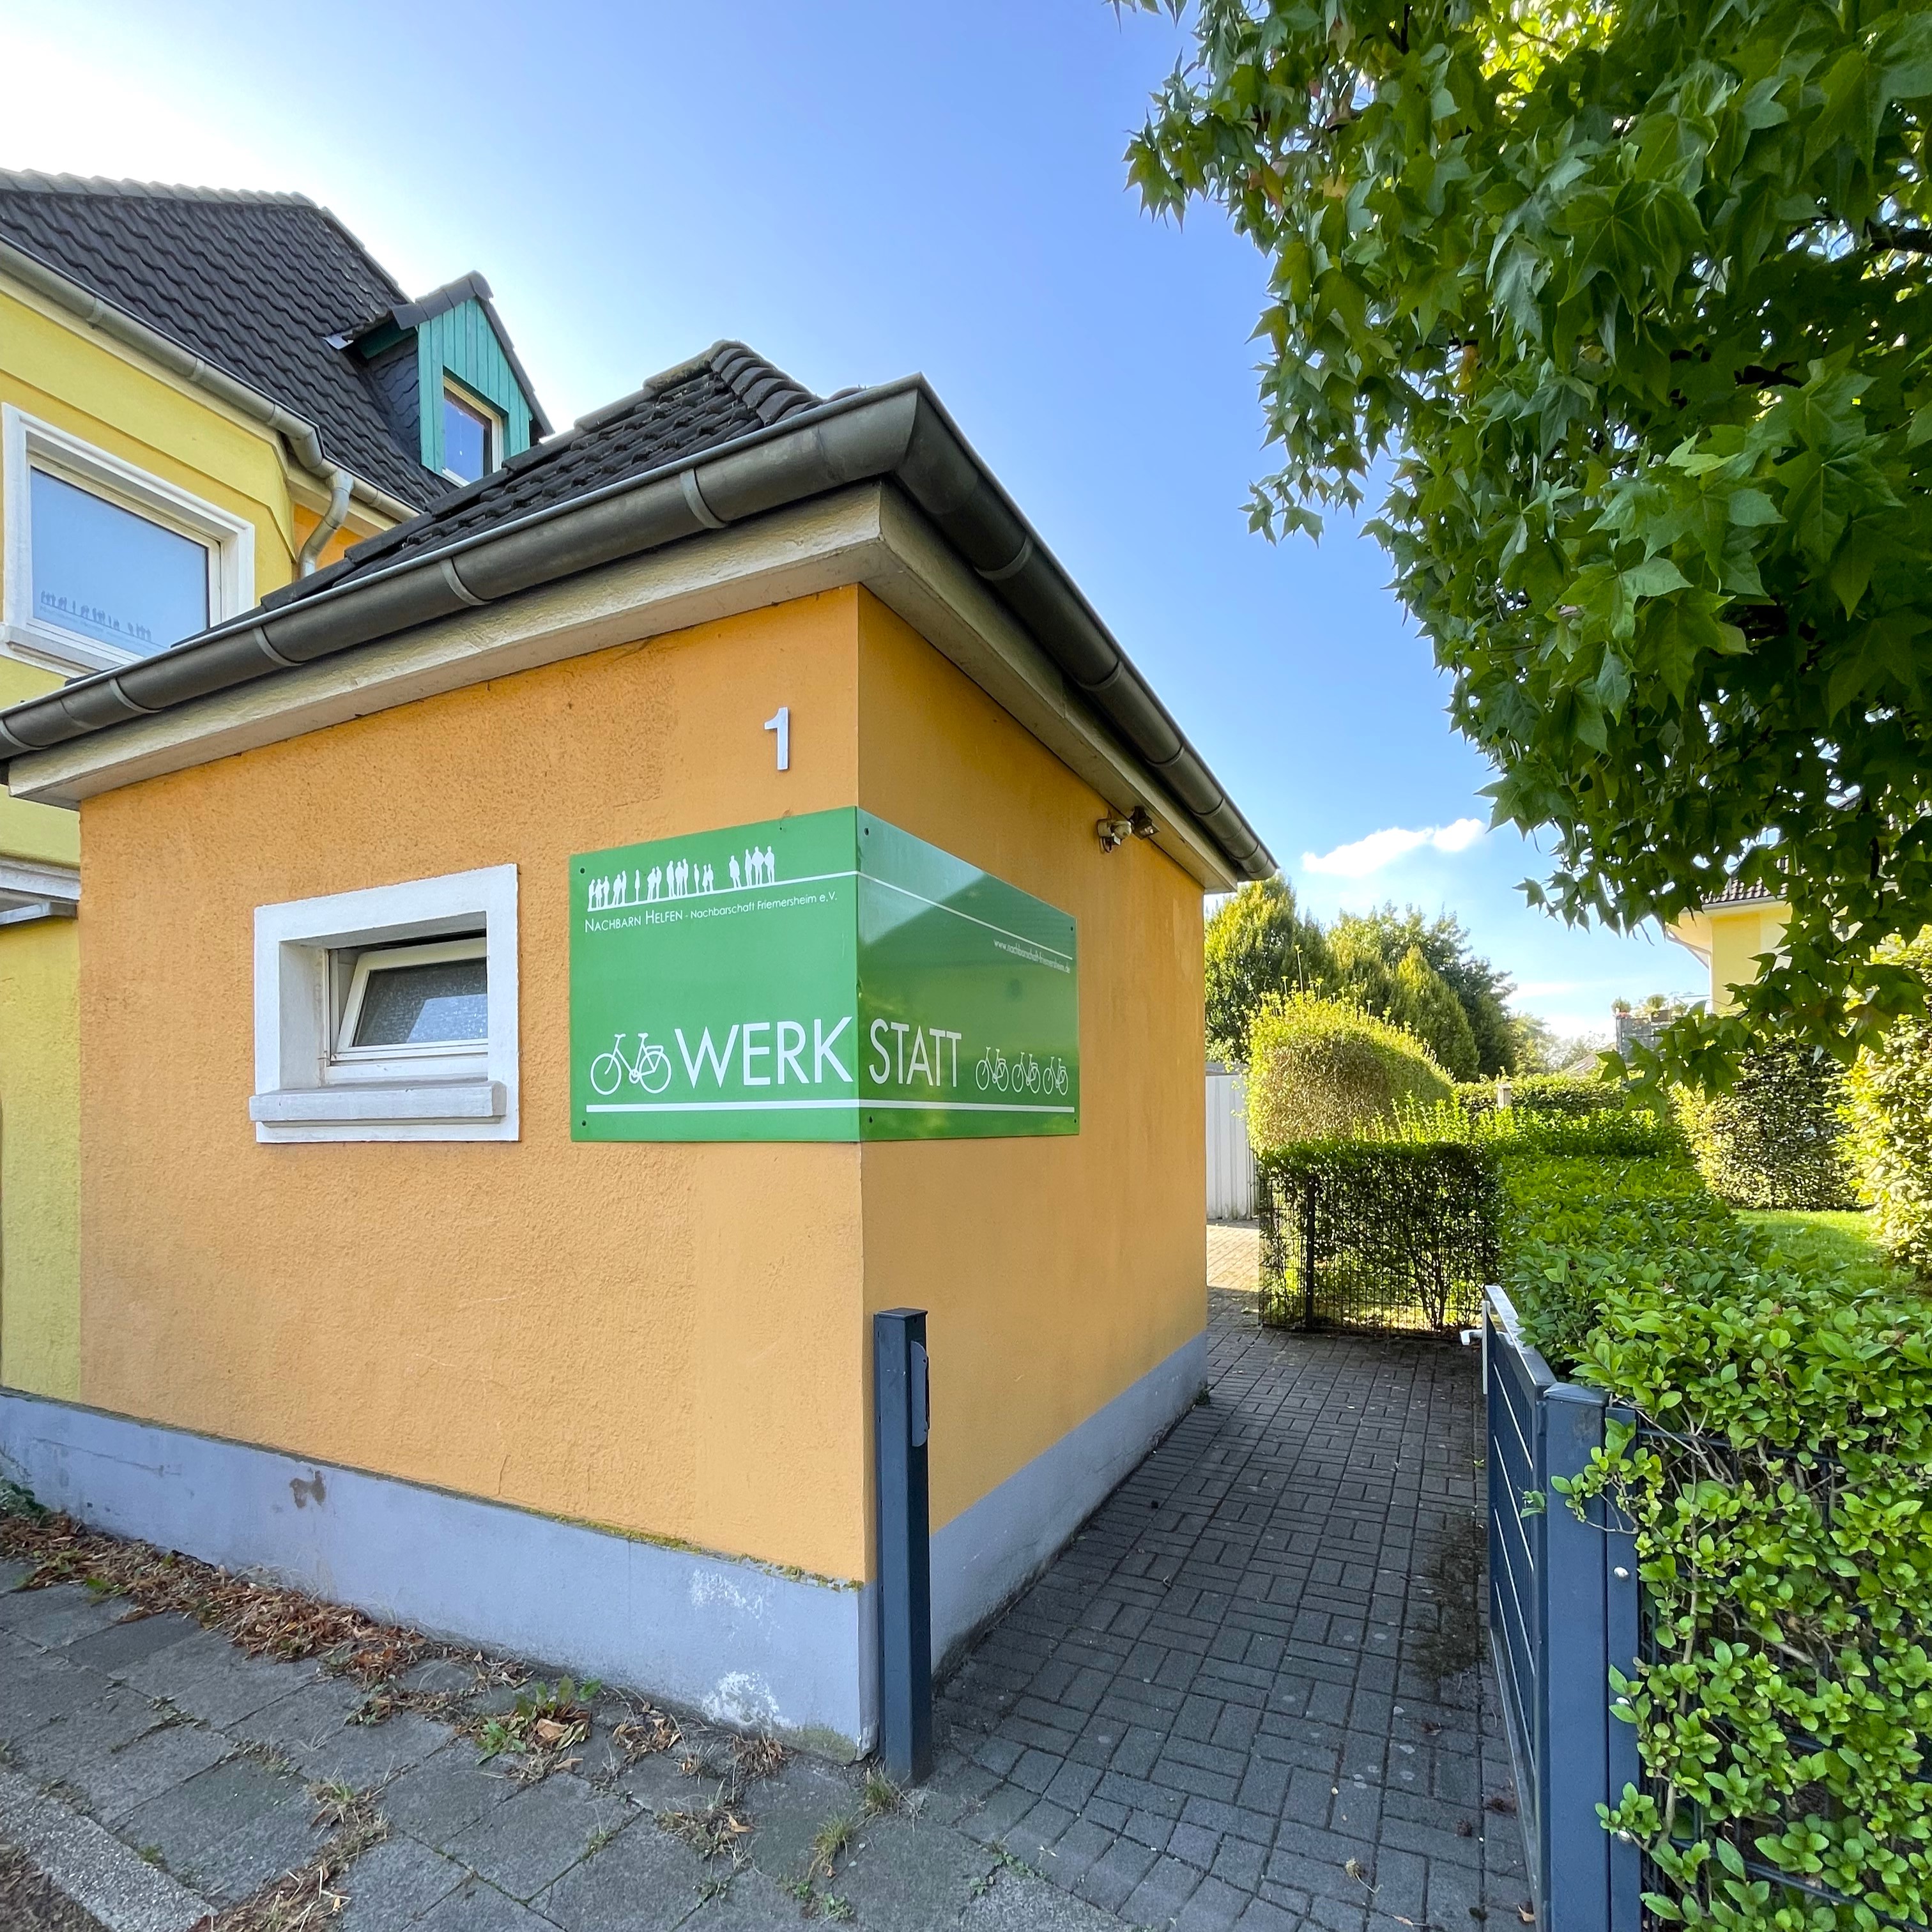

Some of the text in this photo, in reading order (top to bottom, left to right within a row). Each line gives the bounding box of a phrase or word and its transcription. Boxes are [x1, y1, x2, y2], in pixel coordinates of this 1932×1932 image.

[764, 707, 788, 770] 1
[690, 901, 755, 919] Nachbarschaft
[757, 894, 817, 910] Friemersheim
[819, 891, 838, 902] e.V.
[674, 1016, 962, 1089] WERK STATT
